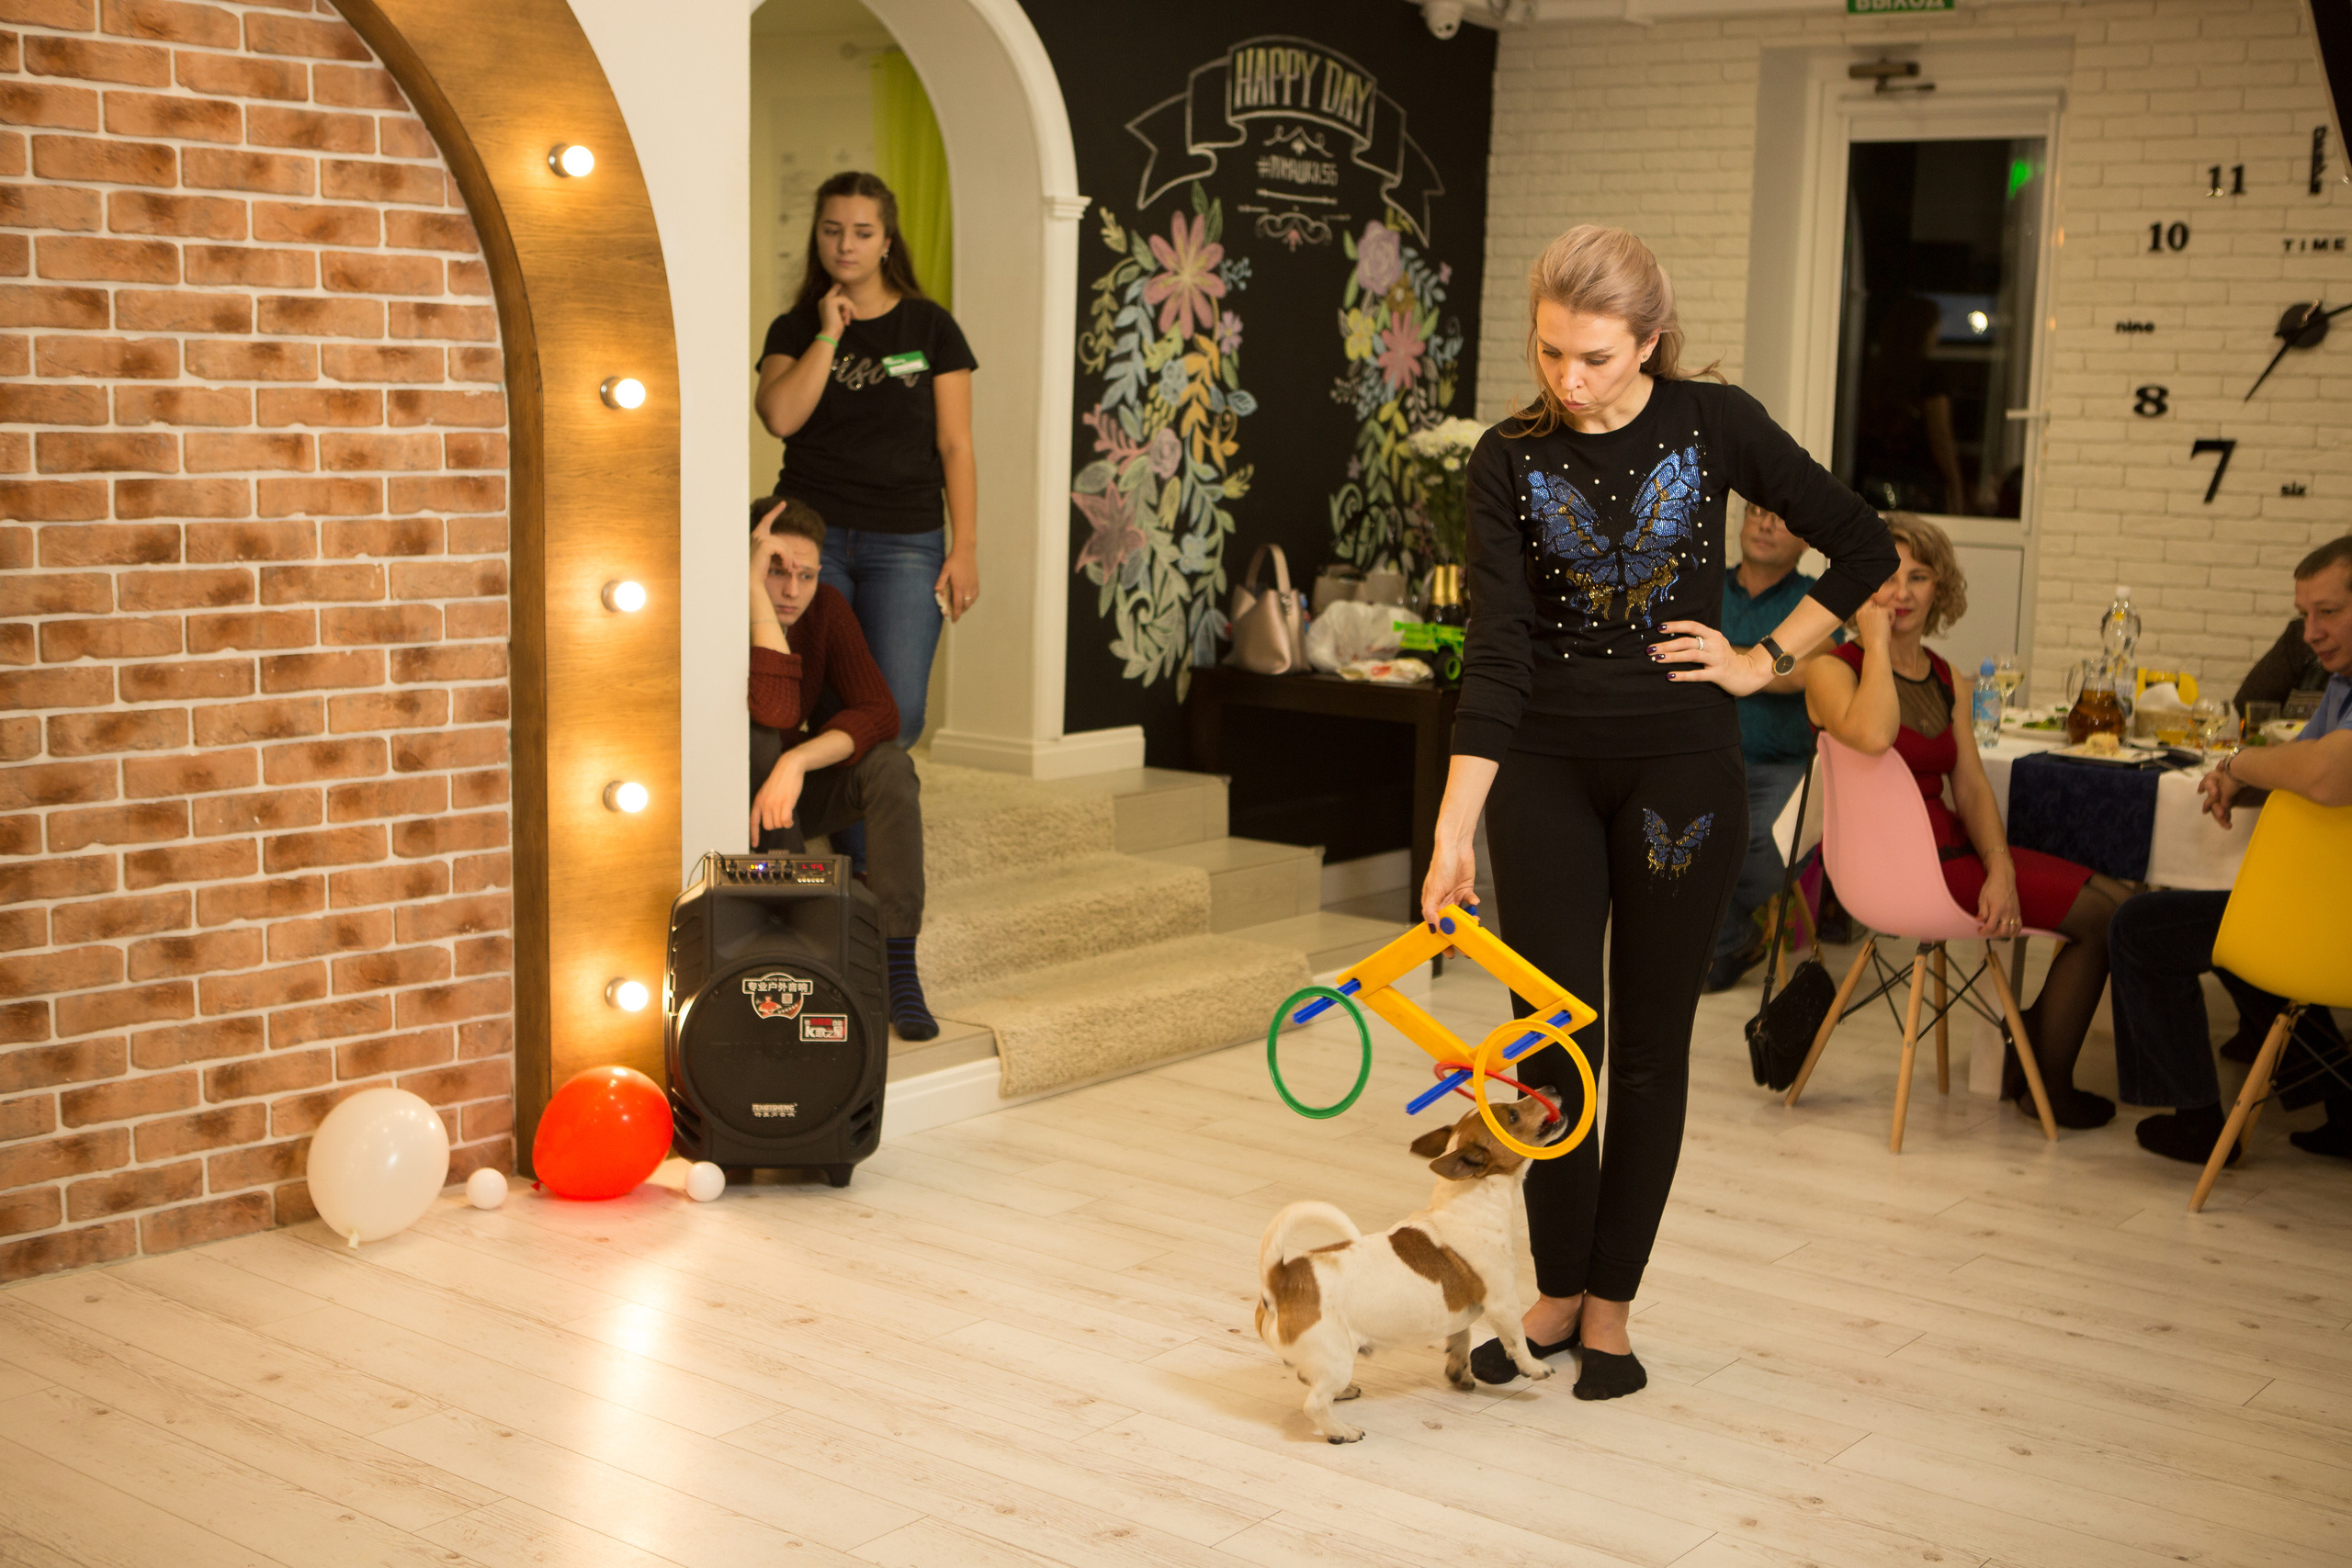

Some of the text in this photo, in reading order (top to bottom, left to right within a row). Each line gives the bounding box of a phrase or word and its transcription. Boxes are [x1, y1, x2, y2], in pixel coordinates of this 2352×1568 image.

[1234, 47, 1374, 128] HAPPY DAY
[2208, 164, 2247, 196] 11
[2148, 221, 2190, 253] 10
[2283, 238, 2346, 253] TIME
[2115, 320, 2155, 333] nine
[2132, 384, 2170, 418] 8
[2190, 437, 2238, 504] 7
[2279, 480, 2307, 498] six
